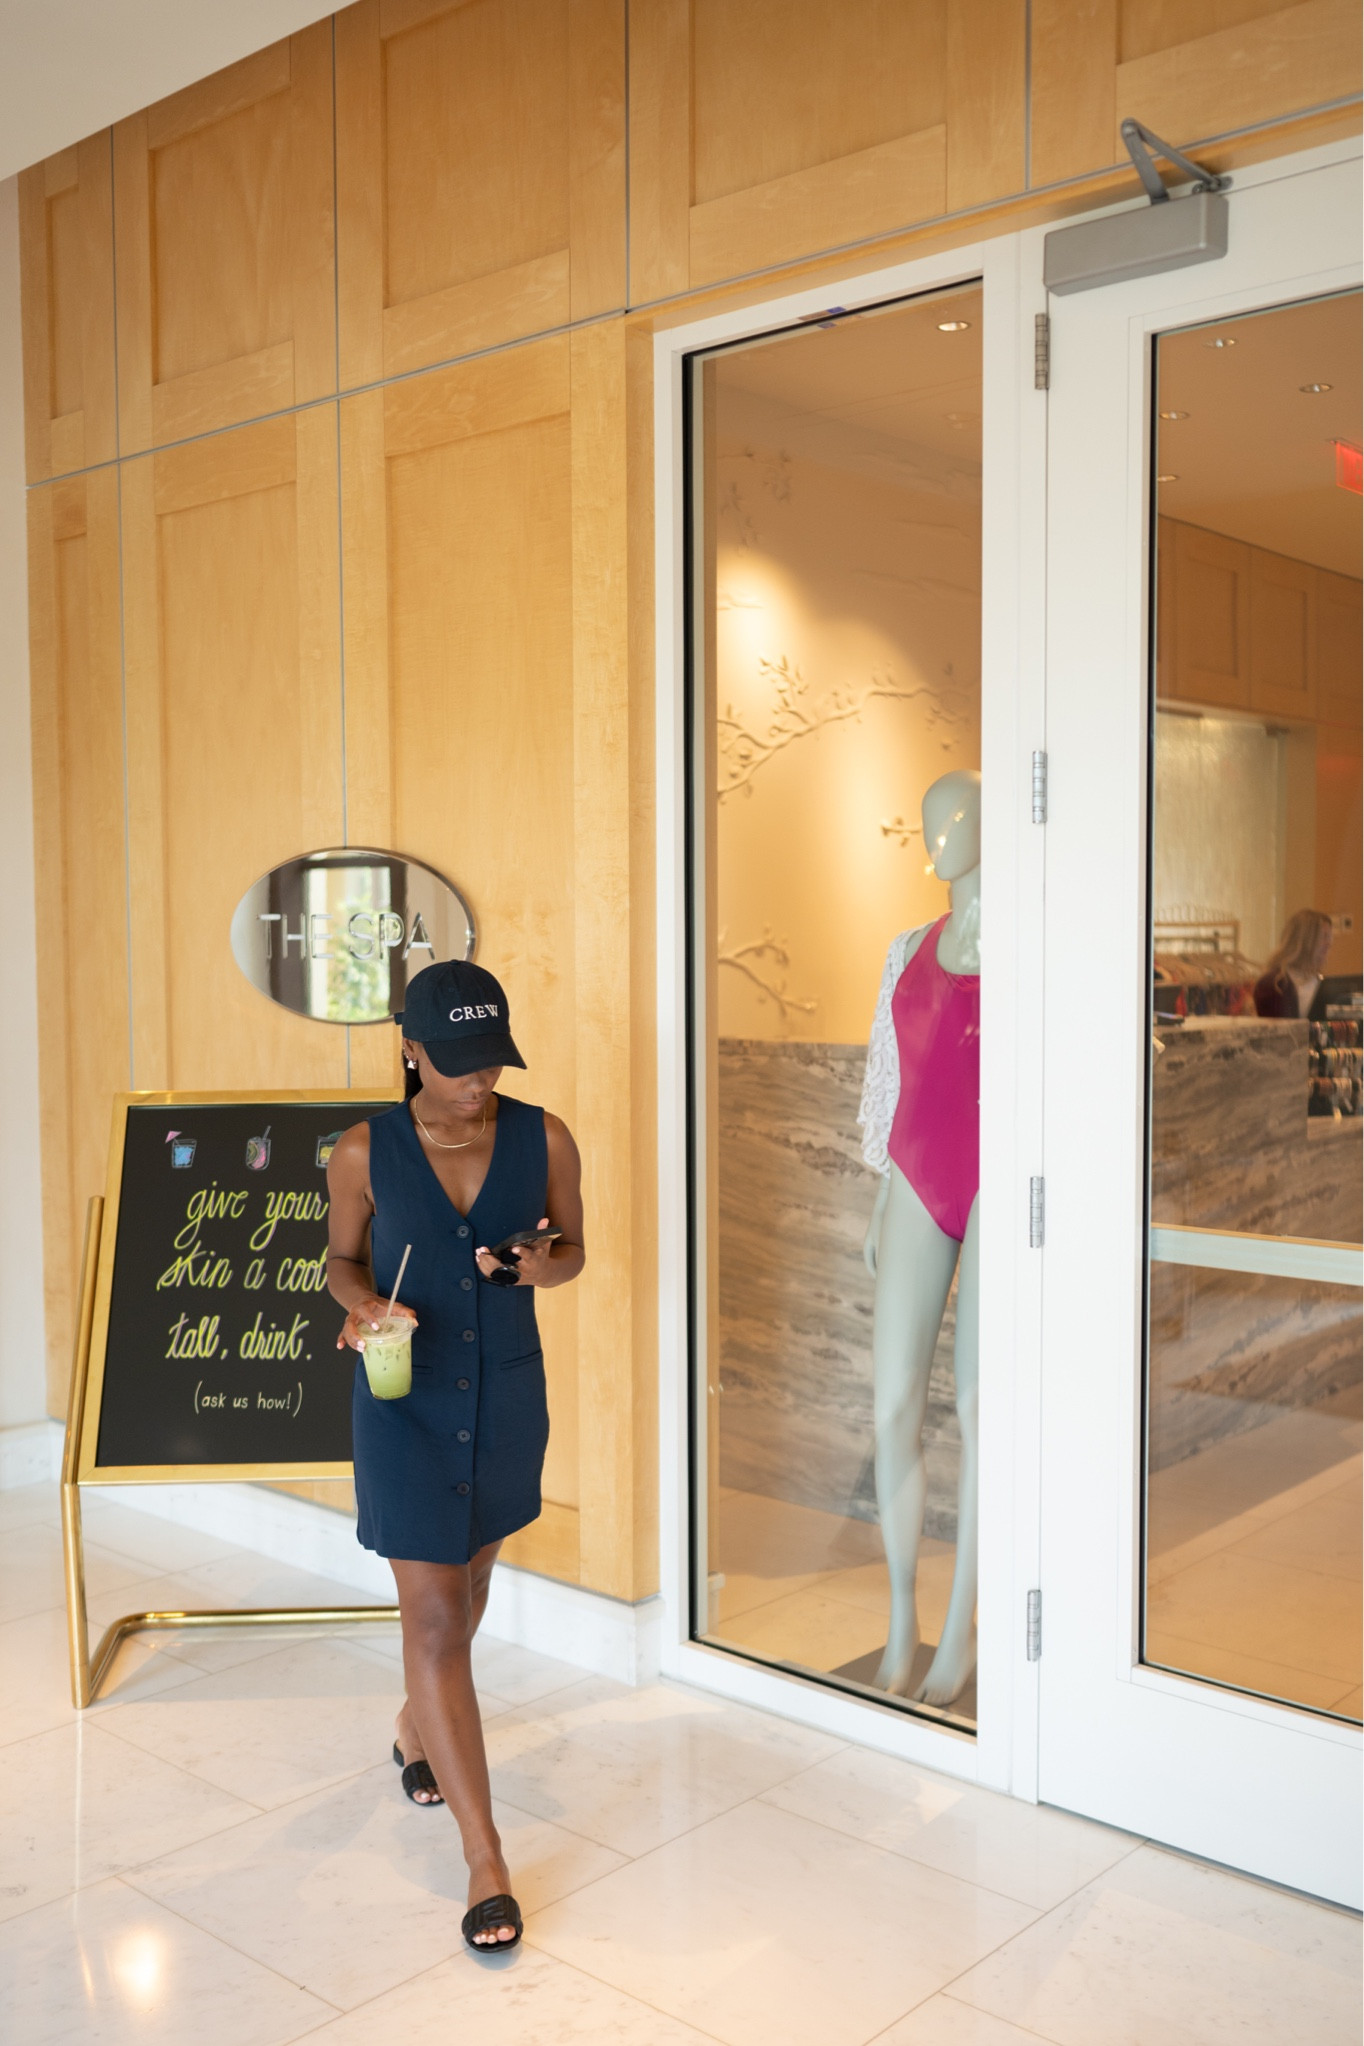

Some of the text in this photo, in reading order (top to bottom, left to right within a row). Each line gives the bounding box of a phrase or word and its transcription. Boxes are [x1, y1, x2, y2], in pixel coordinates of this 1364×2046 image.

[256, 912, 435, 960] THE SPA
[449, 1003, 499, 1022] CREW
[174, 1181, 329, 1251] give your
[156, 1241, 234, 1291] skin
[244, 1260, 268, 1290] a
[165, 1311, 313, 1361] tall, drink.
[194, 1380, 303, 1418] (ask us how!)
